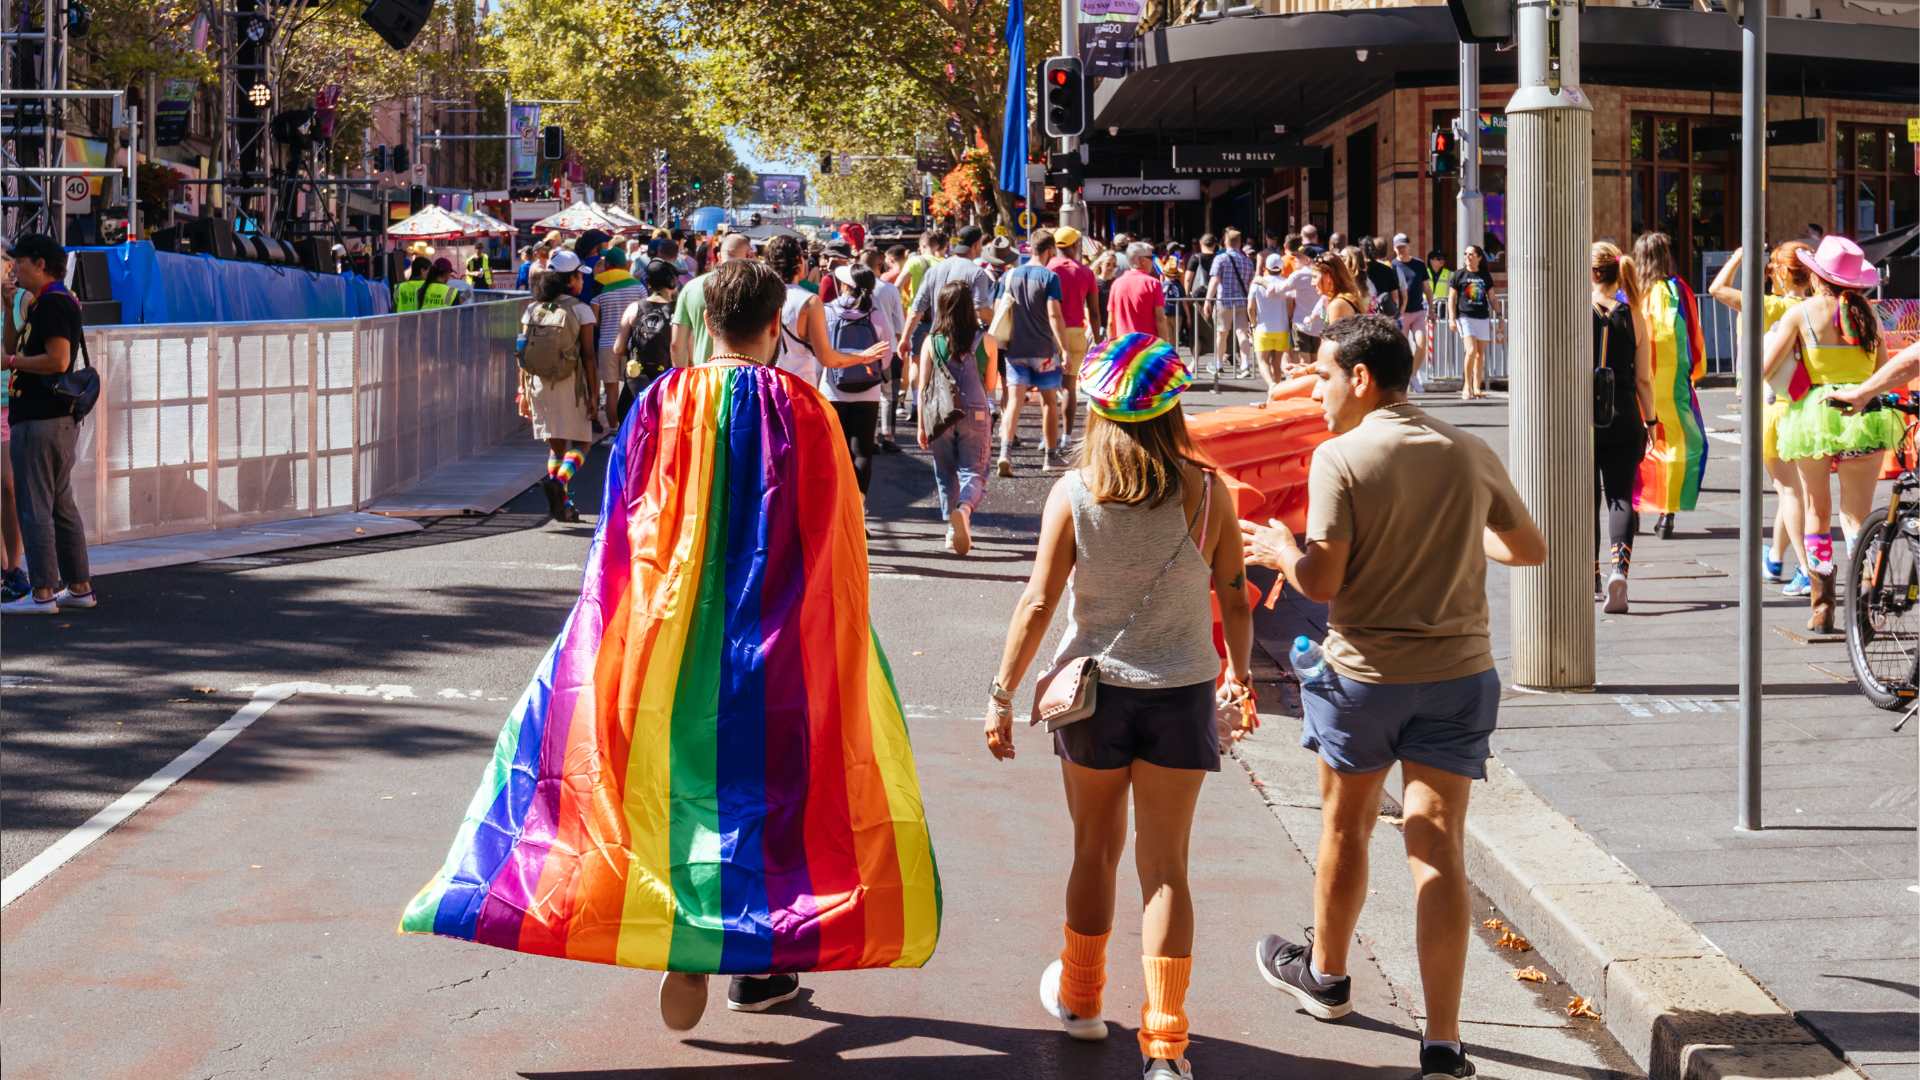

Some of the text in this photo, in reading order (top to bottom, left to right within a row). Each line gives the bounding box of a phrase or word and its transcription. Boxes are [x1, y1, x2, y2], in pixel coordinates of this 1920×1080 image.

[1221, 152, 1277, 161] THE RILEY
[66, 182, 84, 194] 40
[1101, 182, 1181, 196] Throwback.
